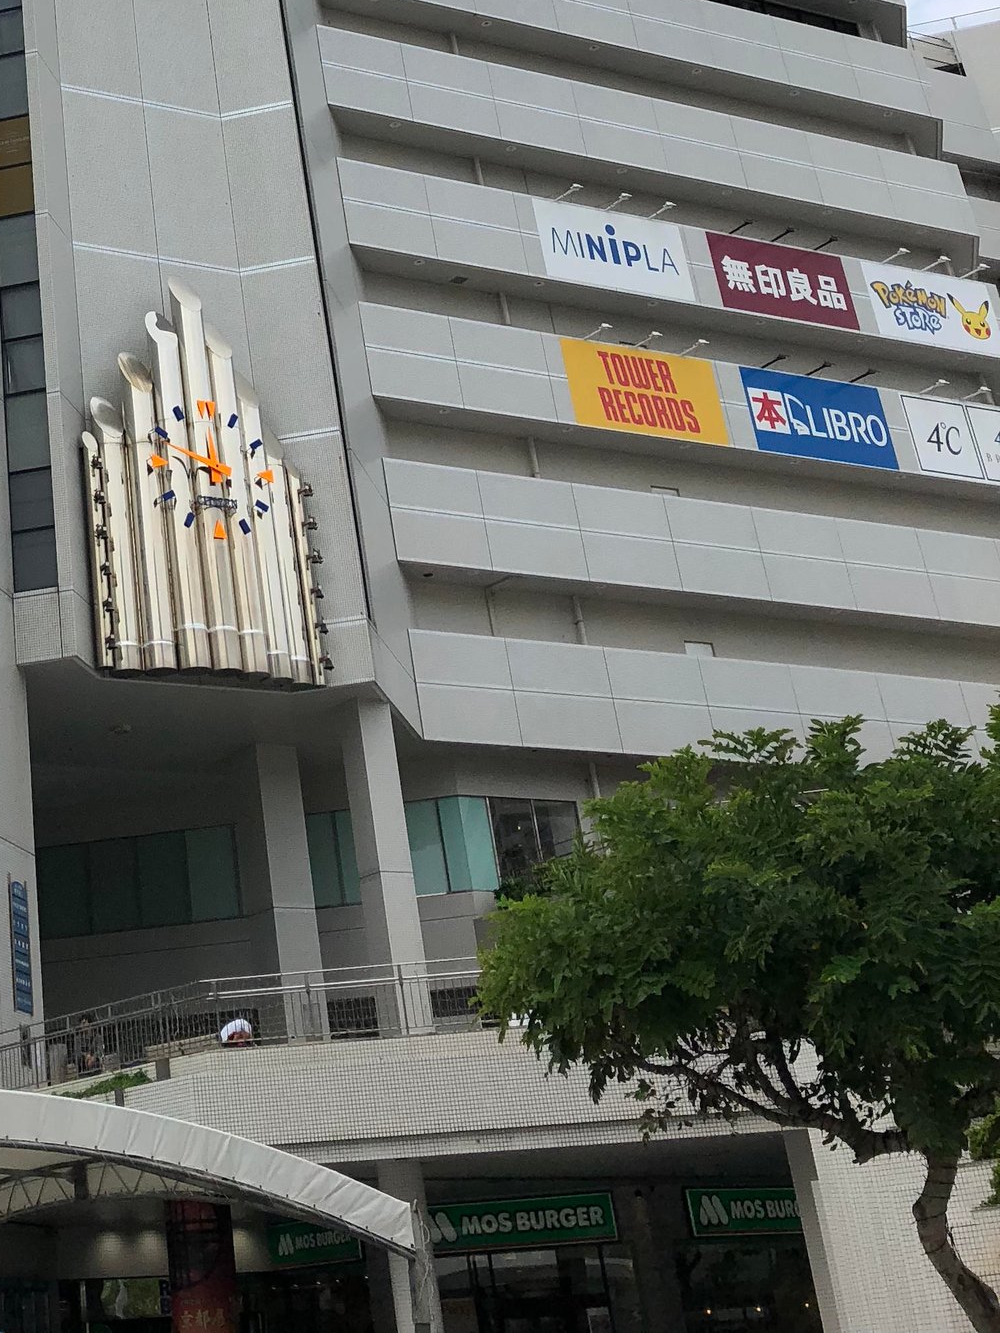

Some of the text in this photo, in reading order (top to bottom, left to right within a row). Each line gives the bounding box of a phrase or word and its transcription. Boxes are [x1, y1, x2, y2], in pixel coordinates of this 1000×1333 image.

[720, 255, 848, 312] 無印良品
[597, 351, 678, 395] TOWER
[598, 387, 701, 434] RECORDS
[751, 391, 888, 447] 本 LIBRO
[461, 1206, 605, 1236] MOS BURGER
[730, 1199, 765, 1219] MOS
[295, 1233, 316, 1250] MOS
